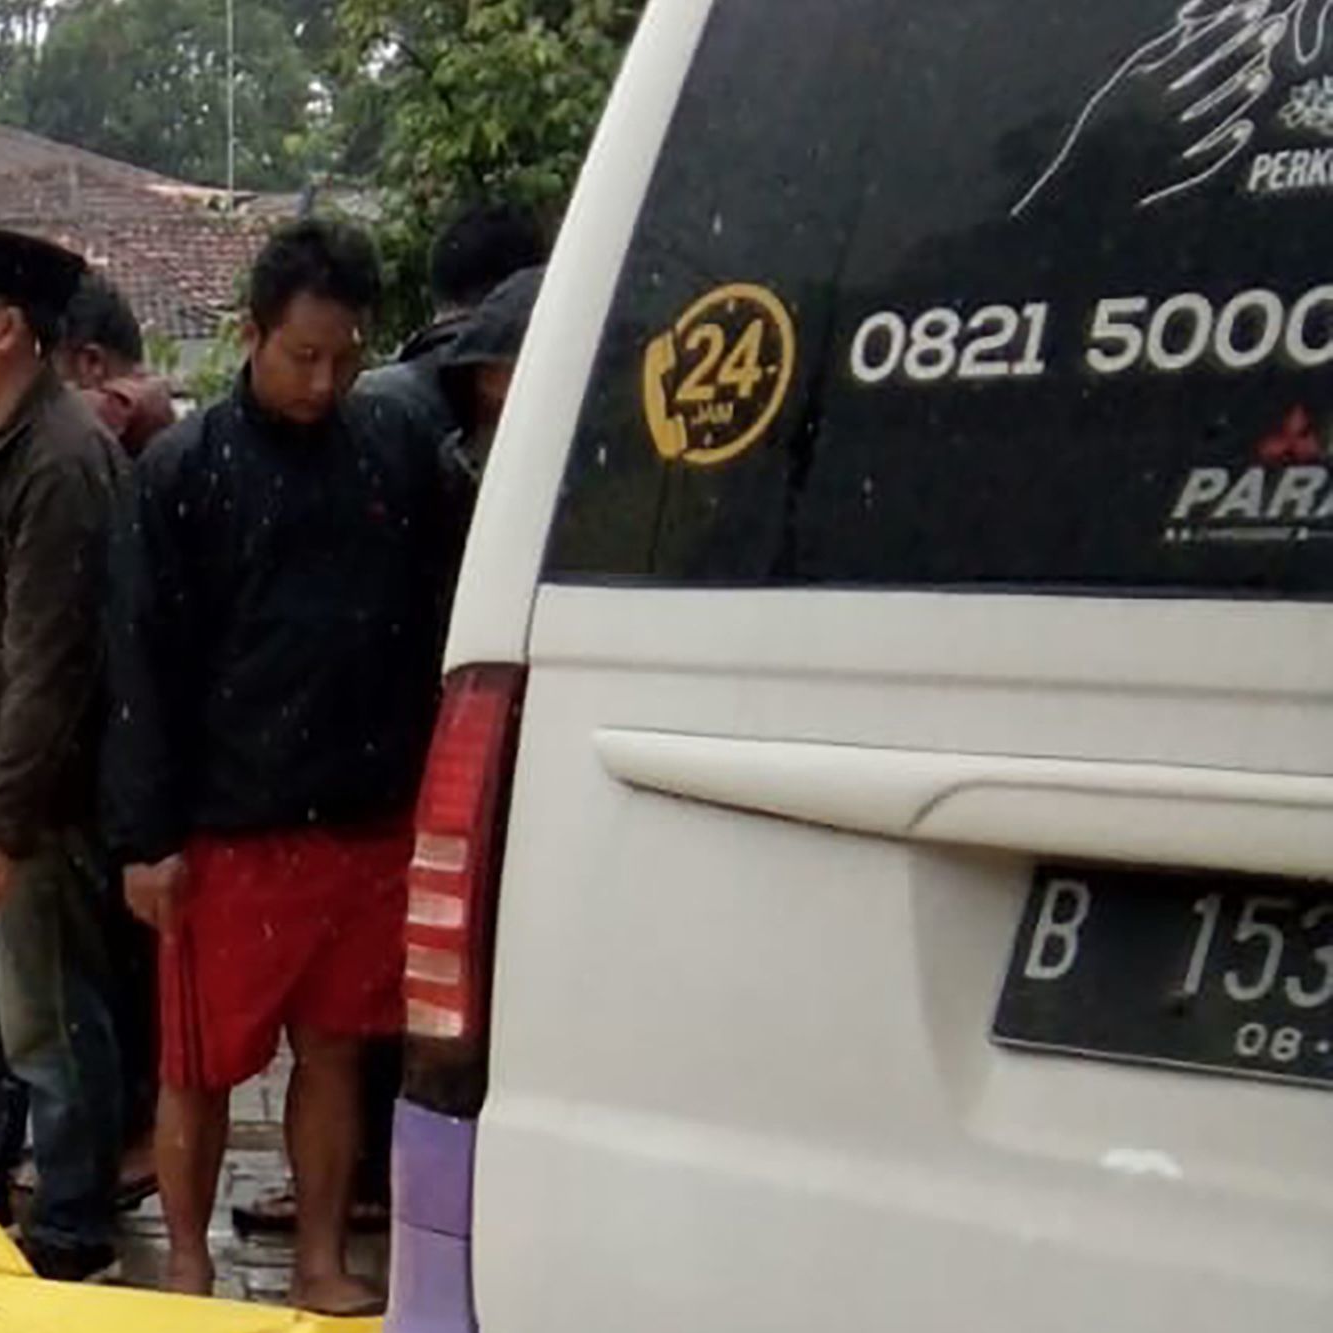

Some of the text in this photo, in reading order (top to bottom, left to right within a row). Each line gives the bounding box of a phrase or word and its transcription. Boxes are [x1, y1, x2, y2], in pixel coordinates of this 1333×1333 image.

[1247, 147, 1333, 192] PERK
[676, 319, 763, 400] 24
[850, 302, 1049, 383] 0821
[1023, 880, 1090, 980] B
